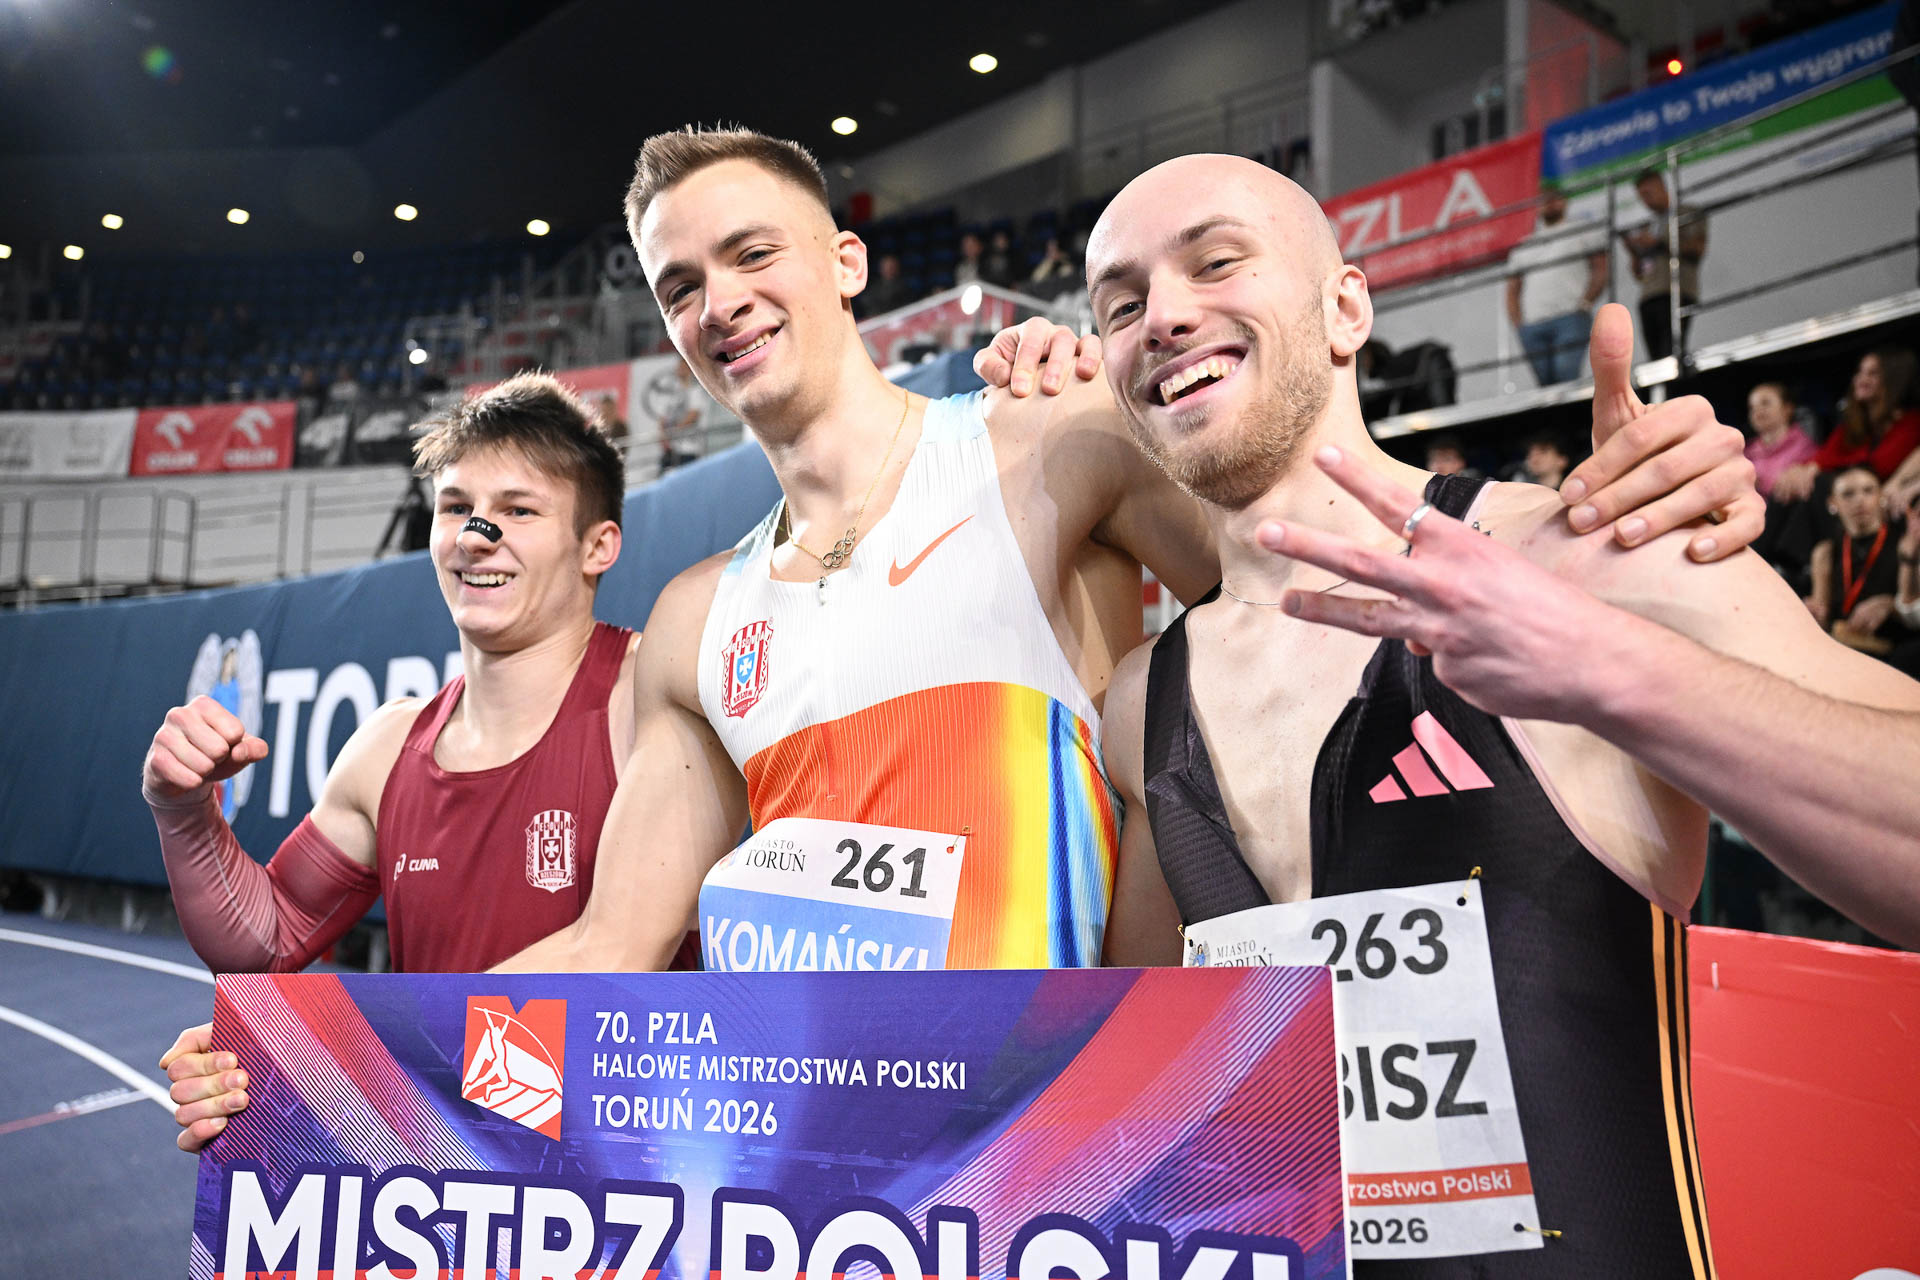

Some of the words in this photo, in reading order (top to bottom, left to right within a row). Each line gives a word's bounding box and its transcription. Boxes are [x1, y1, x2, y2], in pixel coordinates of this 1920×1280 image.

[1662, 99, 1691, 125] to
[408, 857, 440, 872] CUNA
[745, 848, 806, 873] TORUŃ
[831, 838, 927, 899] 261
[1311, 908, 1448, 983] 263
[595, 1011, 636, 1044] 70.
[647, 1012, 718, 1045] PZLA
[593, 1053, 691, 1081] HALOWE
[698, 1055, 868, 1086] MISTRZOSTWA
[876, 1060, 966, 1090] POLSKI
[592, 1088, 694, 1131] TORUŃ
[703, 1100, 778, 1136] 2026
[1442, 1170, 1512, 1195] Polski
